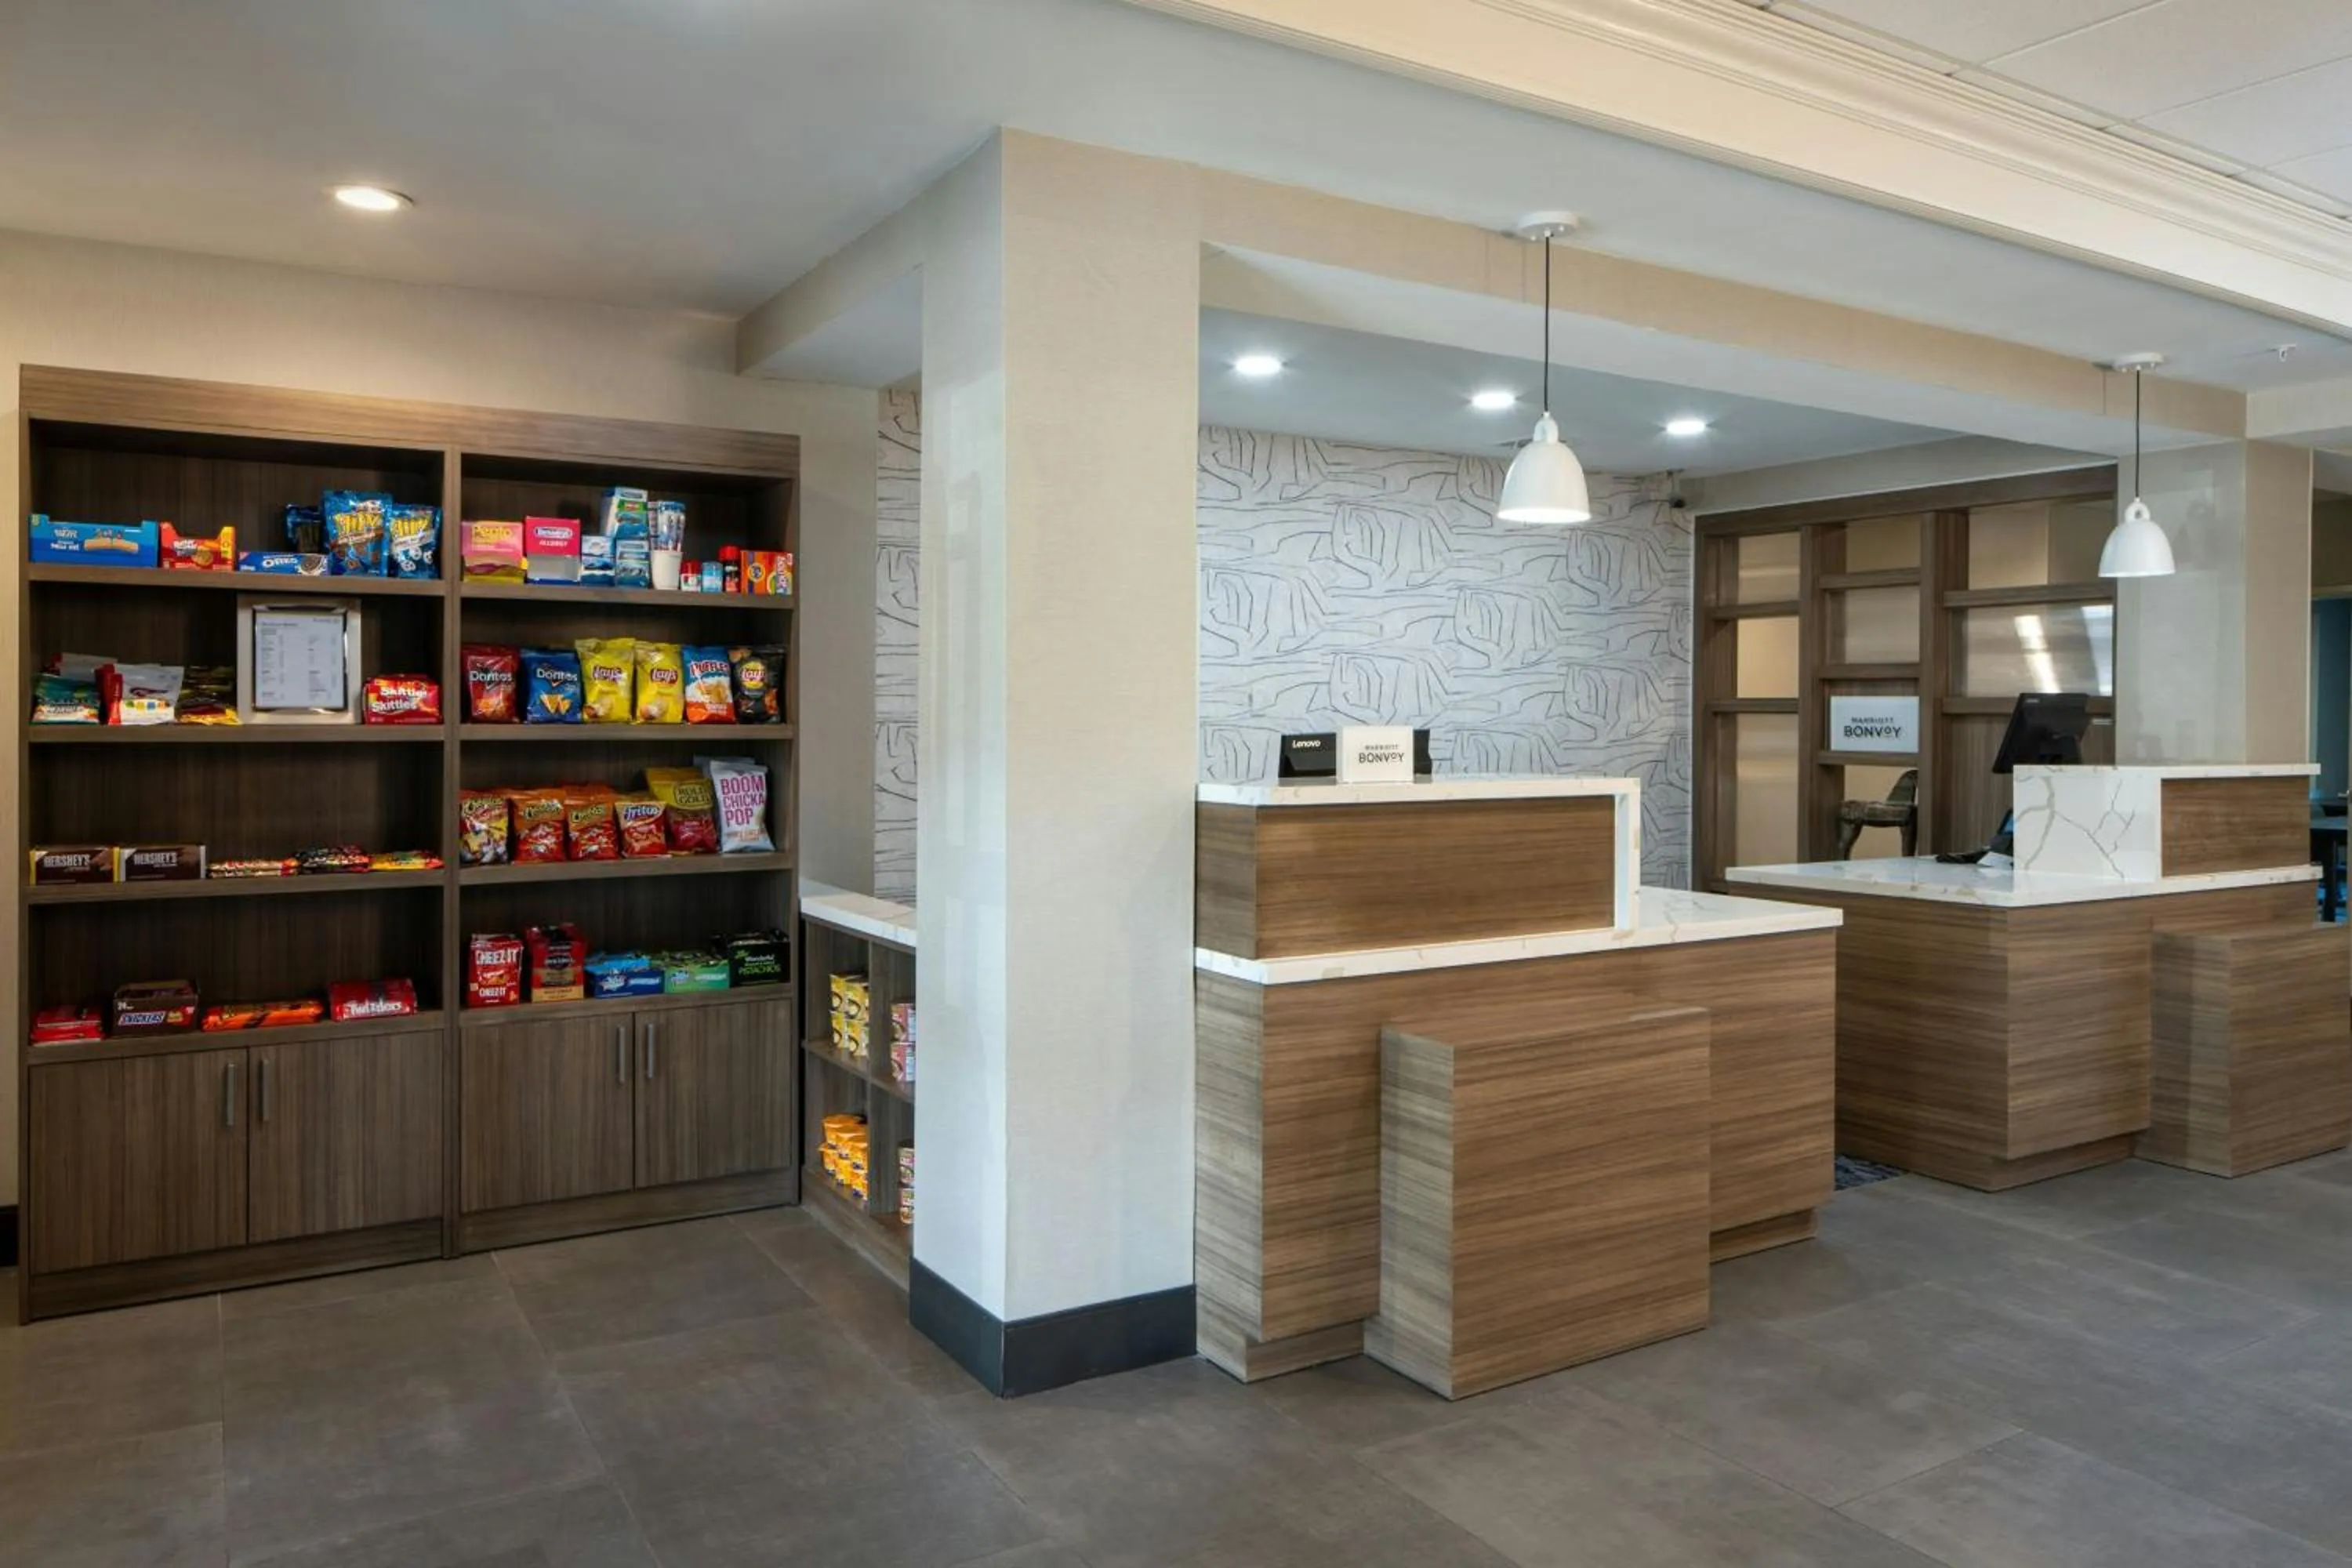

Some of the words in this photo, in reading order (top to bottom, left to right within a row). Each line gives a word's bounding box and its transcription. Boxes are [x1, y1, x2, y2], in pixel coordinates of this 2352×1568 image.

[470, 670, 512, 681] Doritos
[536, 668, 578, 681] Doritos
[1844, 725, 1901, 738] BONVOY
[1292, 739, 1321, 749] Lenovo
[1359, 752, 1404, 763] BONVOY
[720, 775, 764, 795] BOOM
[723, 793, 766, 809] CHICKA
[725, 808, 753, 827] POP
[134, 852, 177, 866] HERSHEY'S
